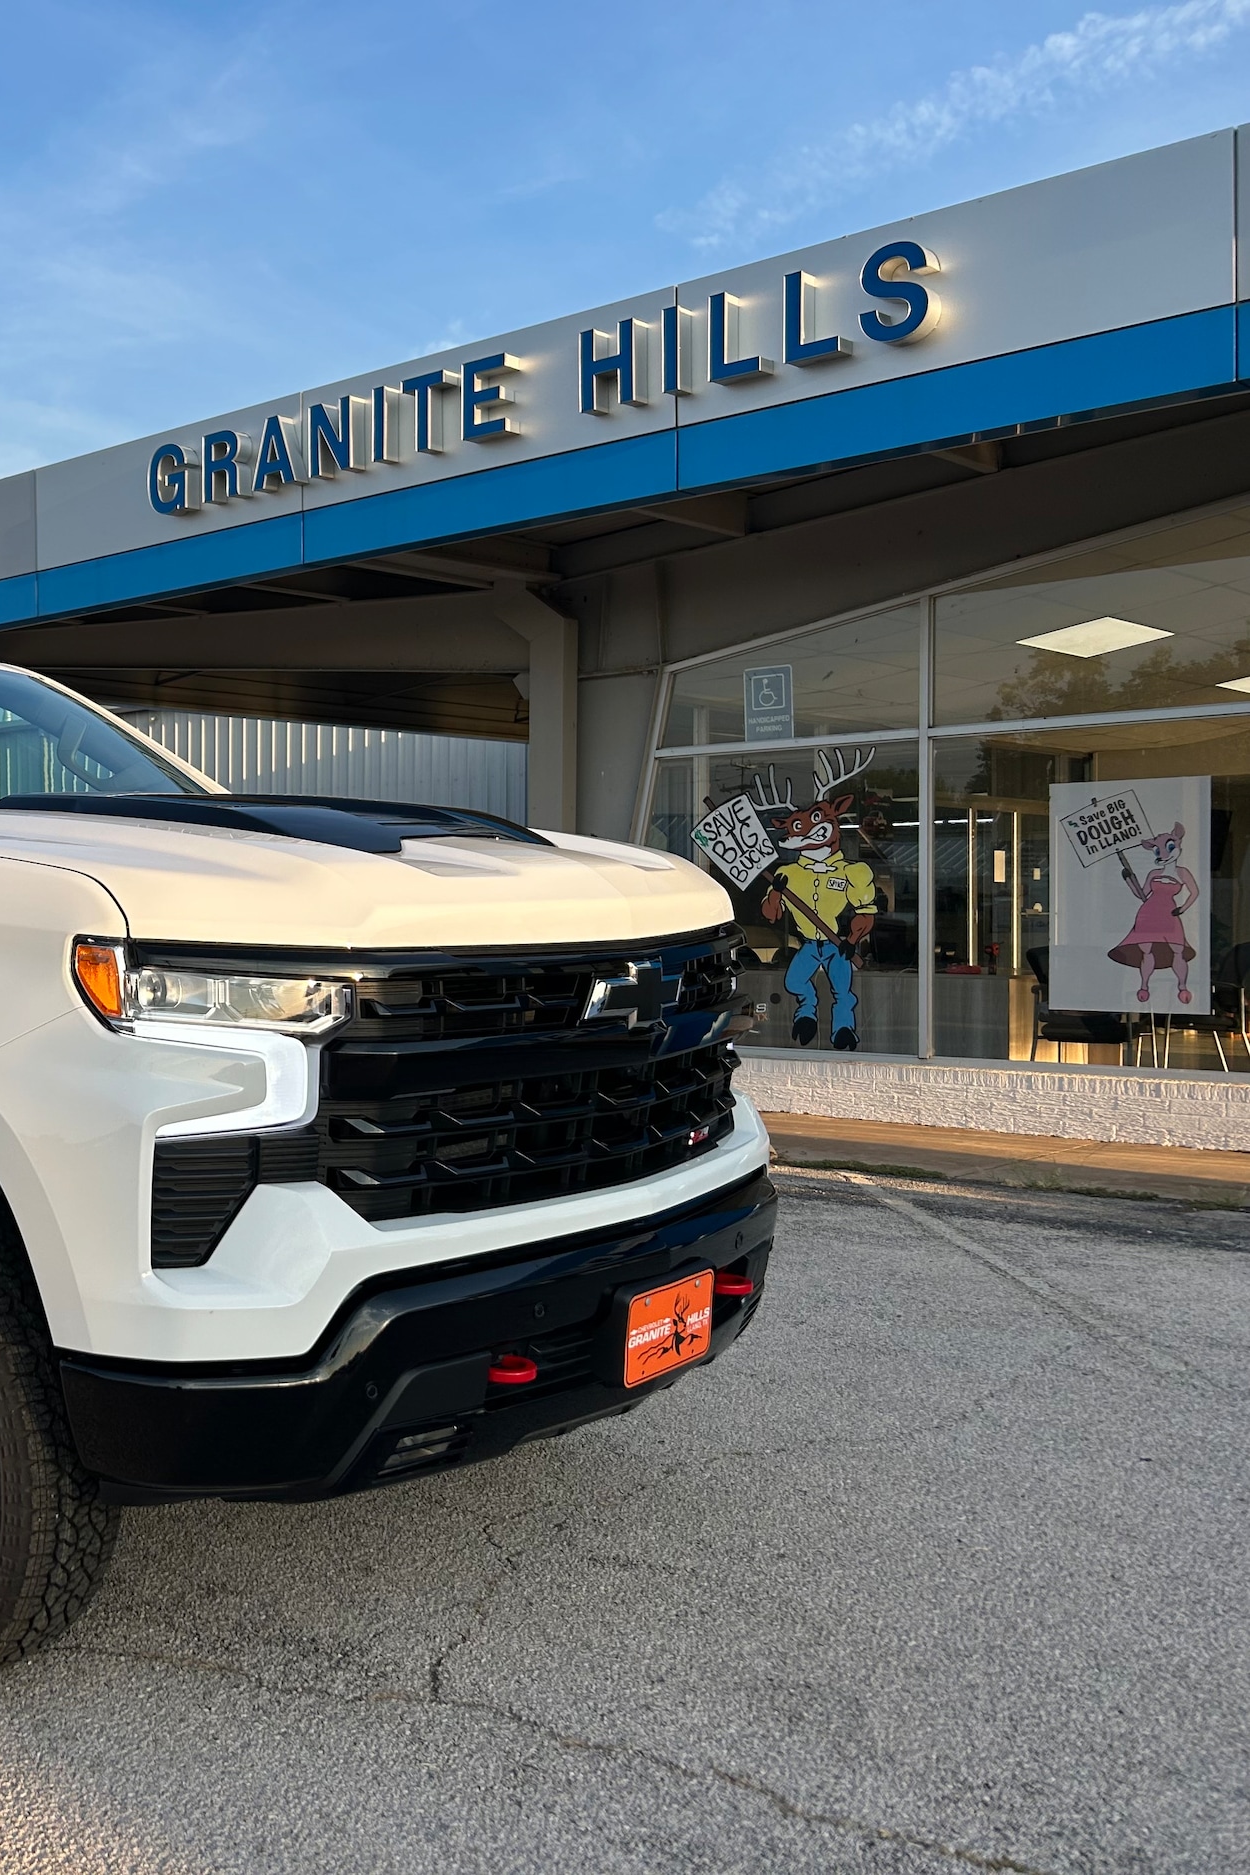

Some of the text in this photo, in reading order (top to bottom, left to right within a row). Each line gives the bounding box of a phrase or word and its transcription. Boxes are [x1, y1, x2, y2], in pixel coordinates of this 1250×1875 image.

[148, 241, 942, 516] GRANITE HILLS
[748, 714, 790, 725] HANDICAPPED
[755, 724, 783, 733] PARKING
[703, 799, 751, 841] SAVE
[1076, 808, 1137, 846] DOUGH
[1079, 810, 1106, 826] Save
[1106, 799, 1127, 814] BIG
[712, 822, 758, 864] BIG
[1085, 823, 1143, 856] in LLANO!
[729, 838, 775, 883] BUCKS
[687, 1306, 711, 1326] HILLS
[628, 1323, 672, 1349] GRANITE
